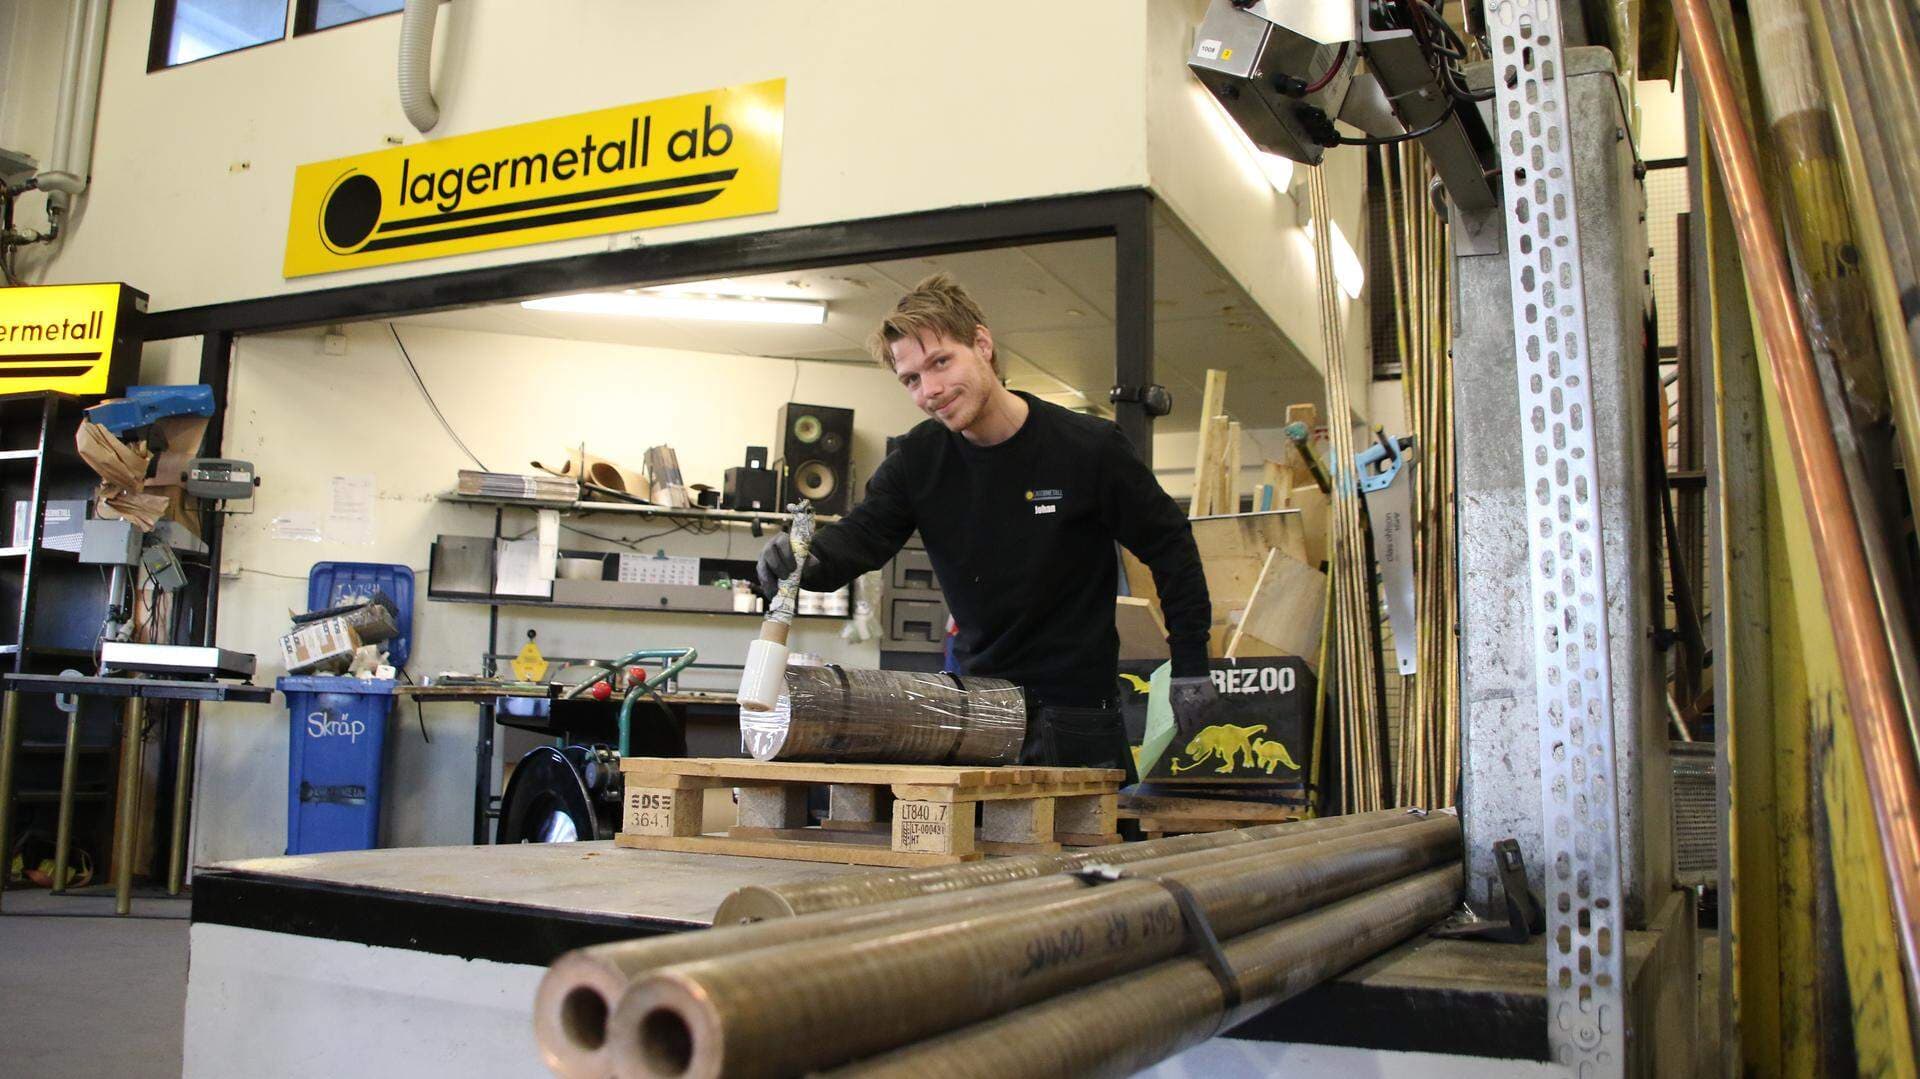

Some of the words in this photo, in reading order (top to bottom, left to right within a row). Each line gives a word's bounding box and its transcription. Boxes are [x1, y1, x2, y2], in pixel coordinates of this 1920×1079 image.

[400, 115, 651, 212] lagermetall
[667, 105, 734, 162] ab
[1210, 667, 1296, 694] REZOO
[308, 712, 366, 745] Skräp
[902, 804, 930, 821] LT840
